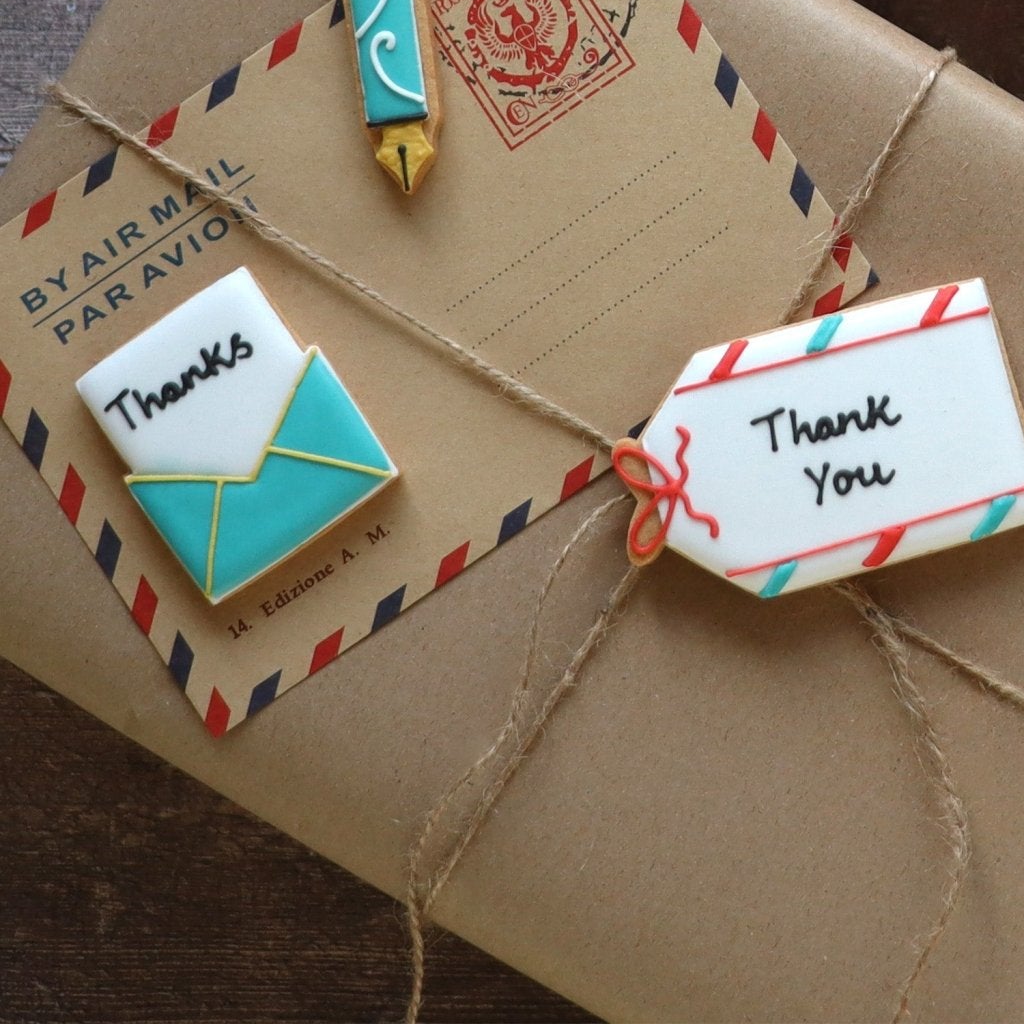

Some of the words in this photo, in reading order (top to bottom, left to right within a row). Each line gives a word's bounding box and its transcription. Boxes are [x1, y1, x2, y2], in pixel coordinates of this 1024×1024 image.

[20, 267, 69, 314] BY
[82, 221, 147, 276] AIR
[149, 159, 245, 226] MAIL
[53, 283, 135, 345] PAR
[104, 332, 254, 430] Thanks
[750, 394, 903, 453] Thank
[803, 462, 896, 506] You
[227, 618, 253, 640] 14.
[259, 562, 336, 618] Edizione
[341, 547, 360, 564] A.
[365, 523, 391, 545] M.
